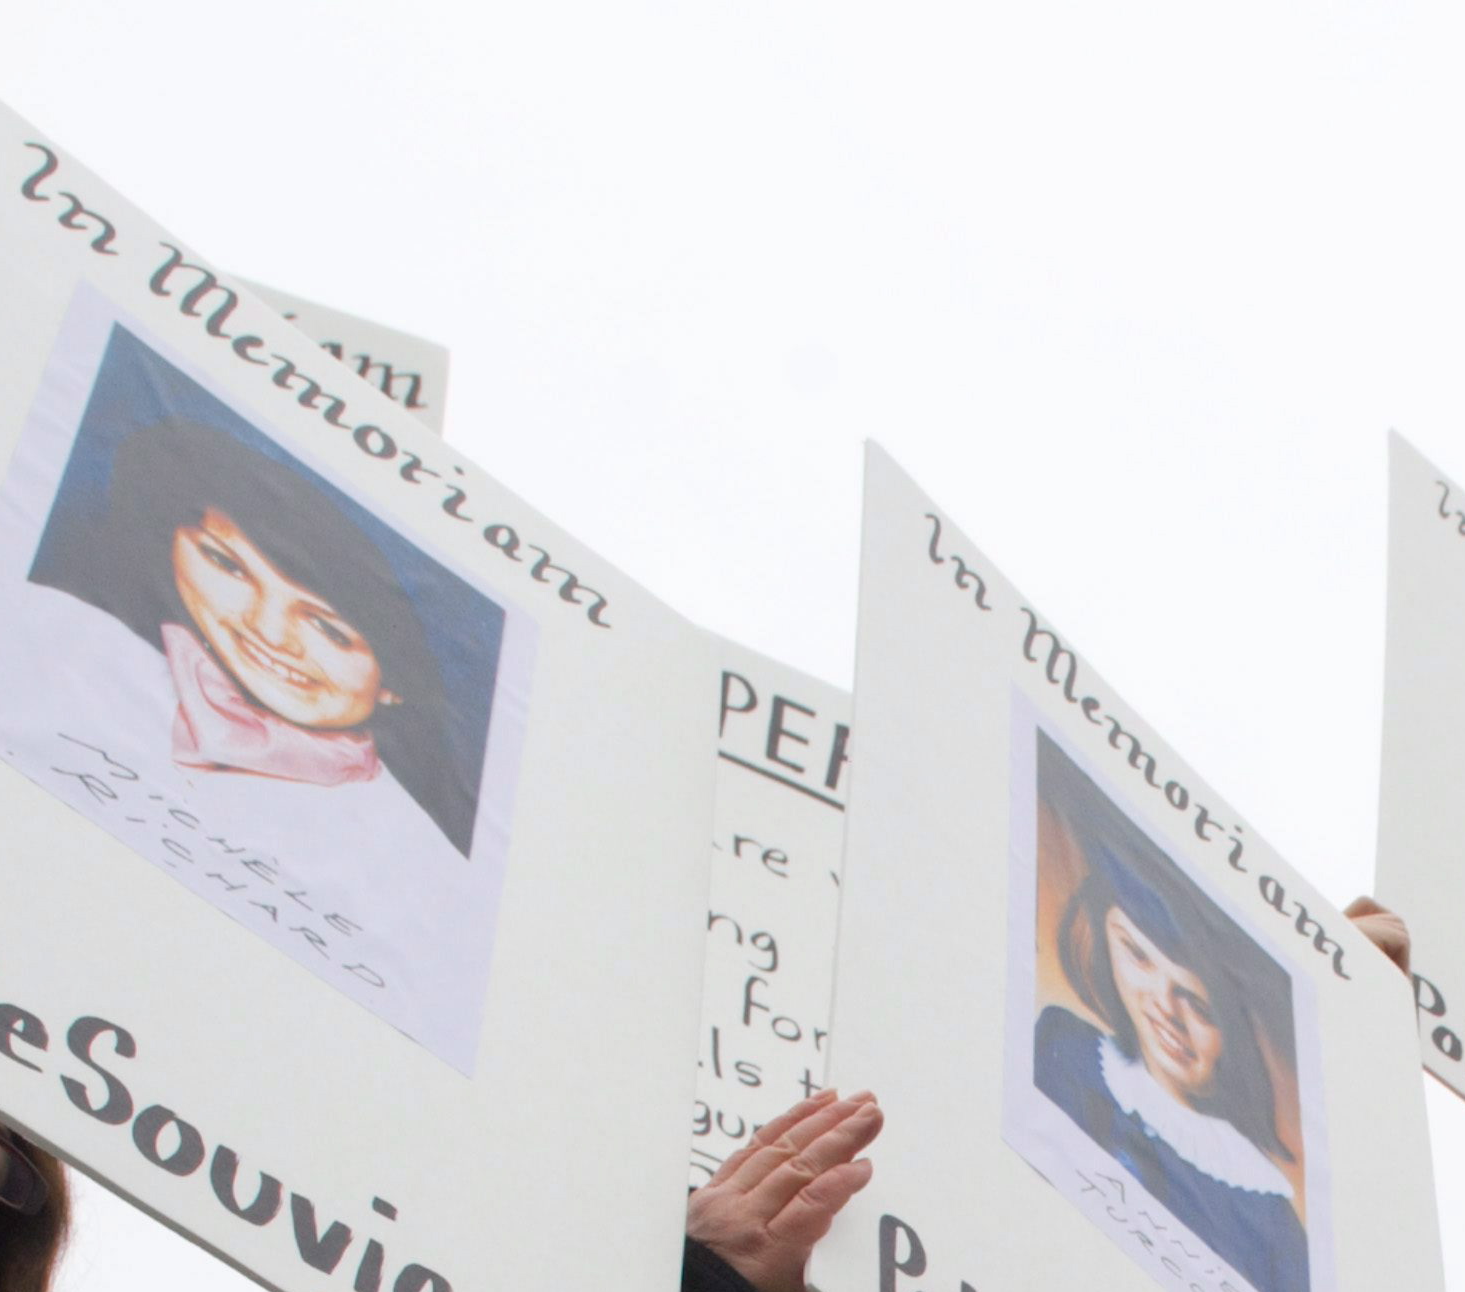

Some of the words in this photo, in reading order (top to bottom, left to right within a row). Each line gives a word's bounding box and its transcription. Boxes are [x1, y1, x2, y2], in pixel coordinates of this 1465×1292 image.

[20, 142, 119, 256] In
[149, 242, 611, 628] Memoriam
[925, 513, 992, 610] In
[1020, 607, 1352, 980] Memoriam
